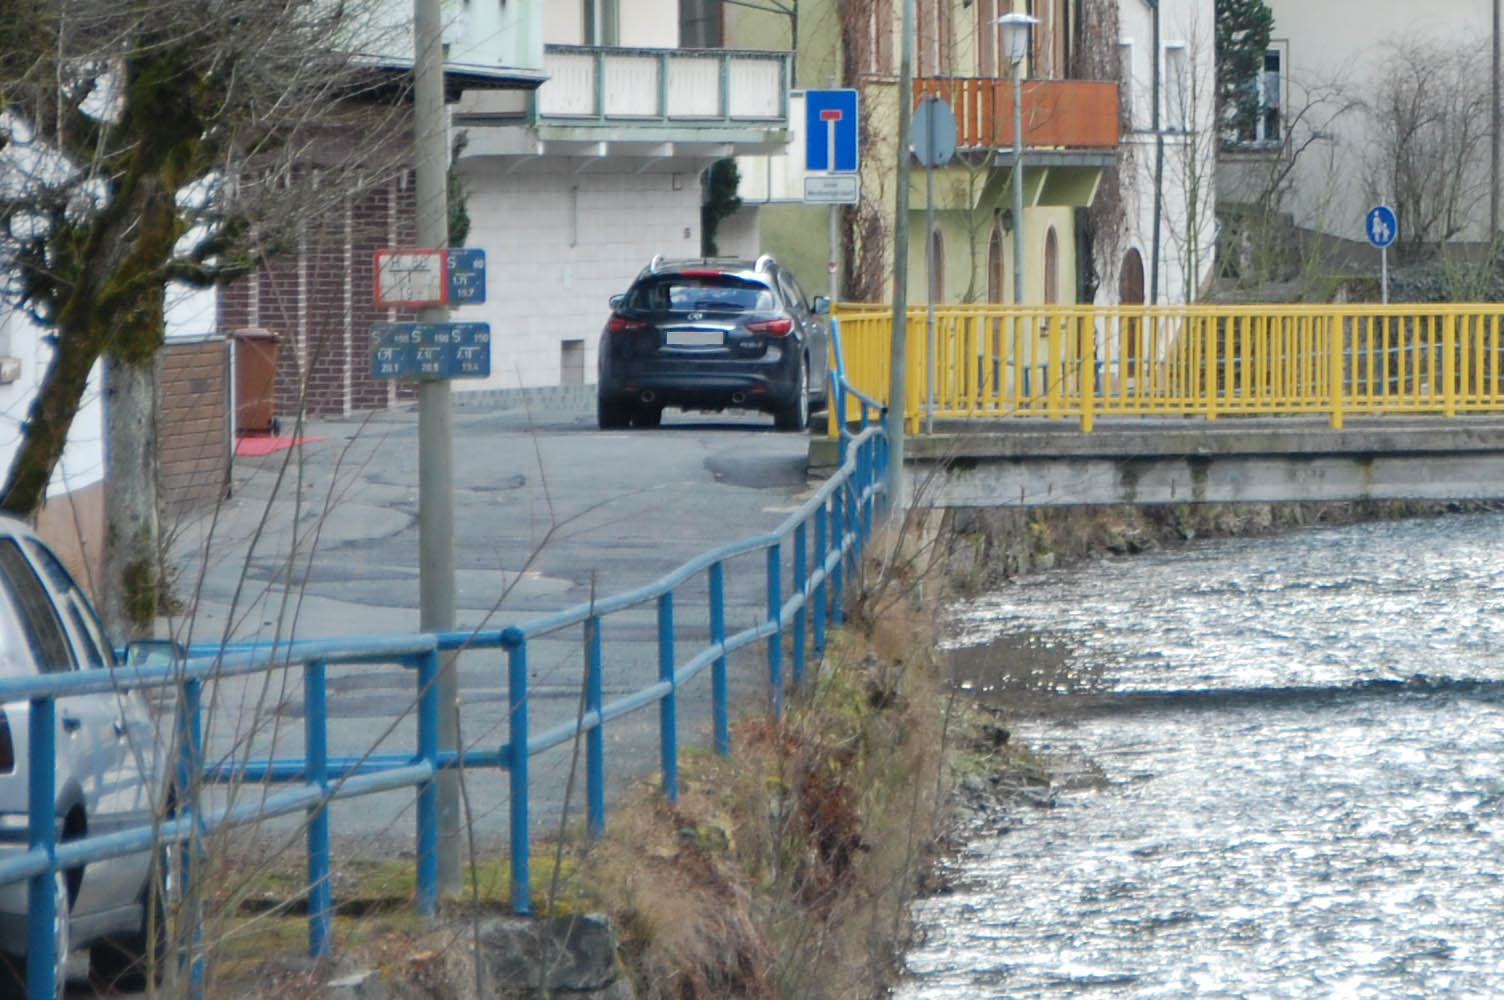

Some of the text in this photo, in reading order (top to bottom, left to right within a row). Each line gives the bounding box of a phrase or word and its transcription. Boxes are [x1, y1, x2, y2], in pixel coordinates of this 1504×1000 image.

[447, 256, 456, 269] S
[371, 330, 381, 345] S
[411, 330, 422, 343] S
[451, 329, 461, 343] S
